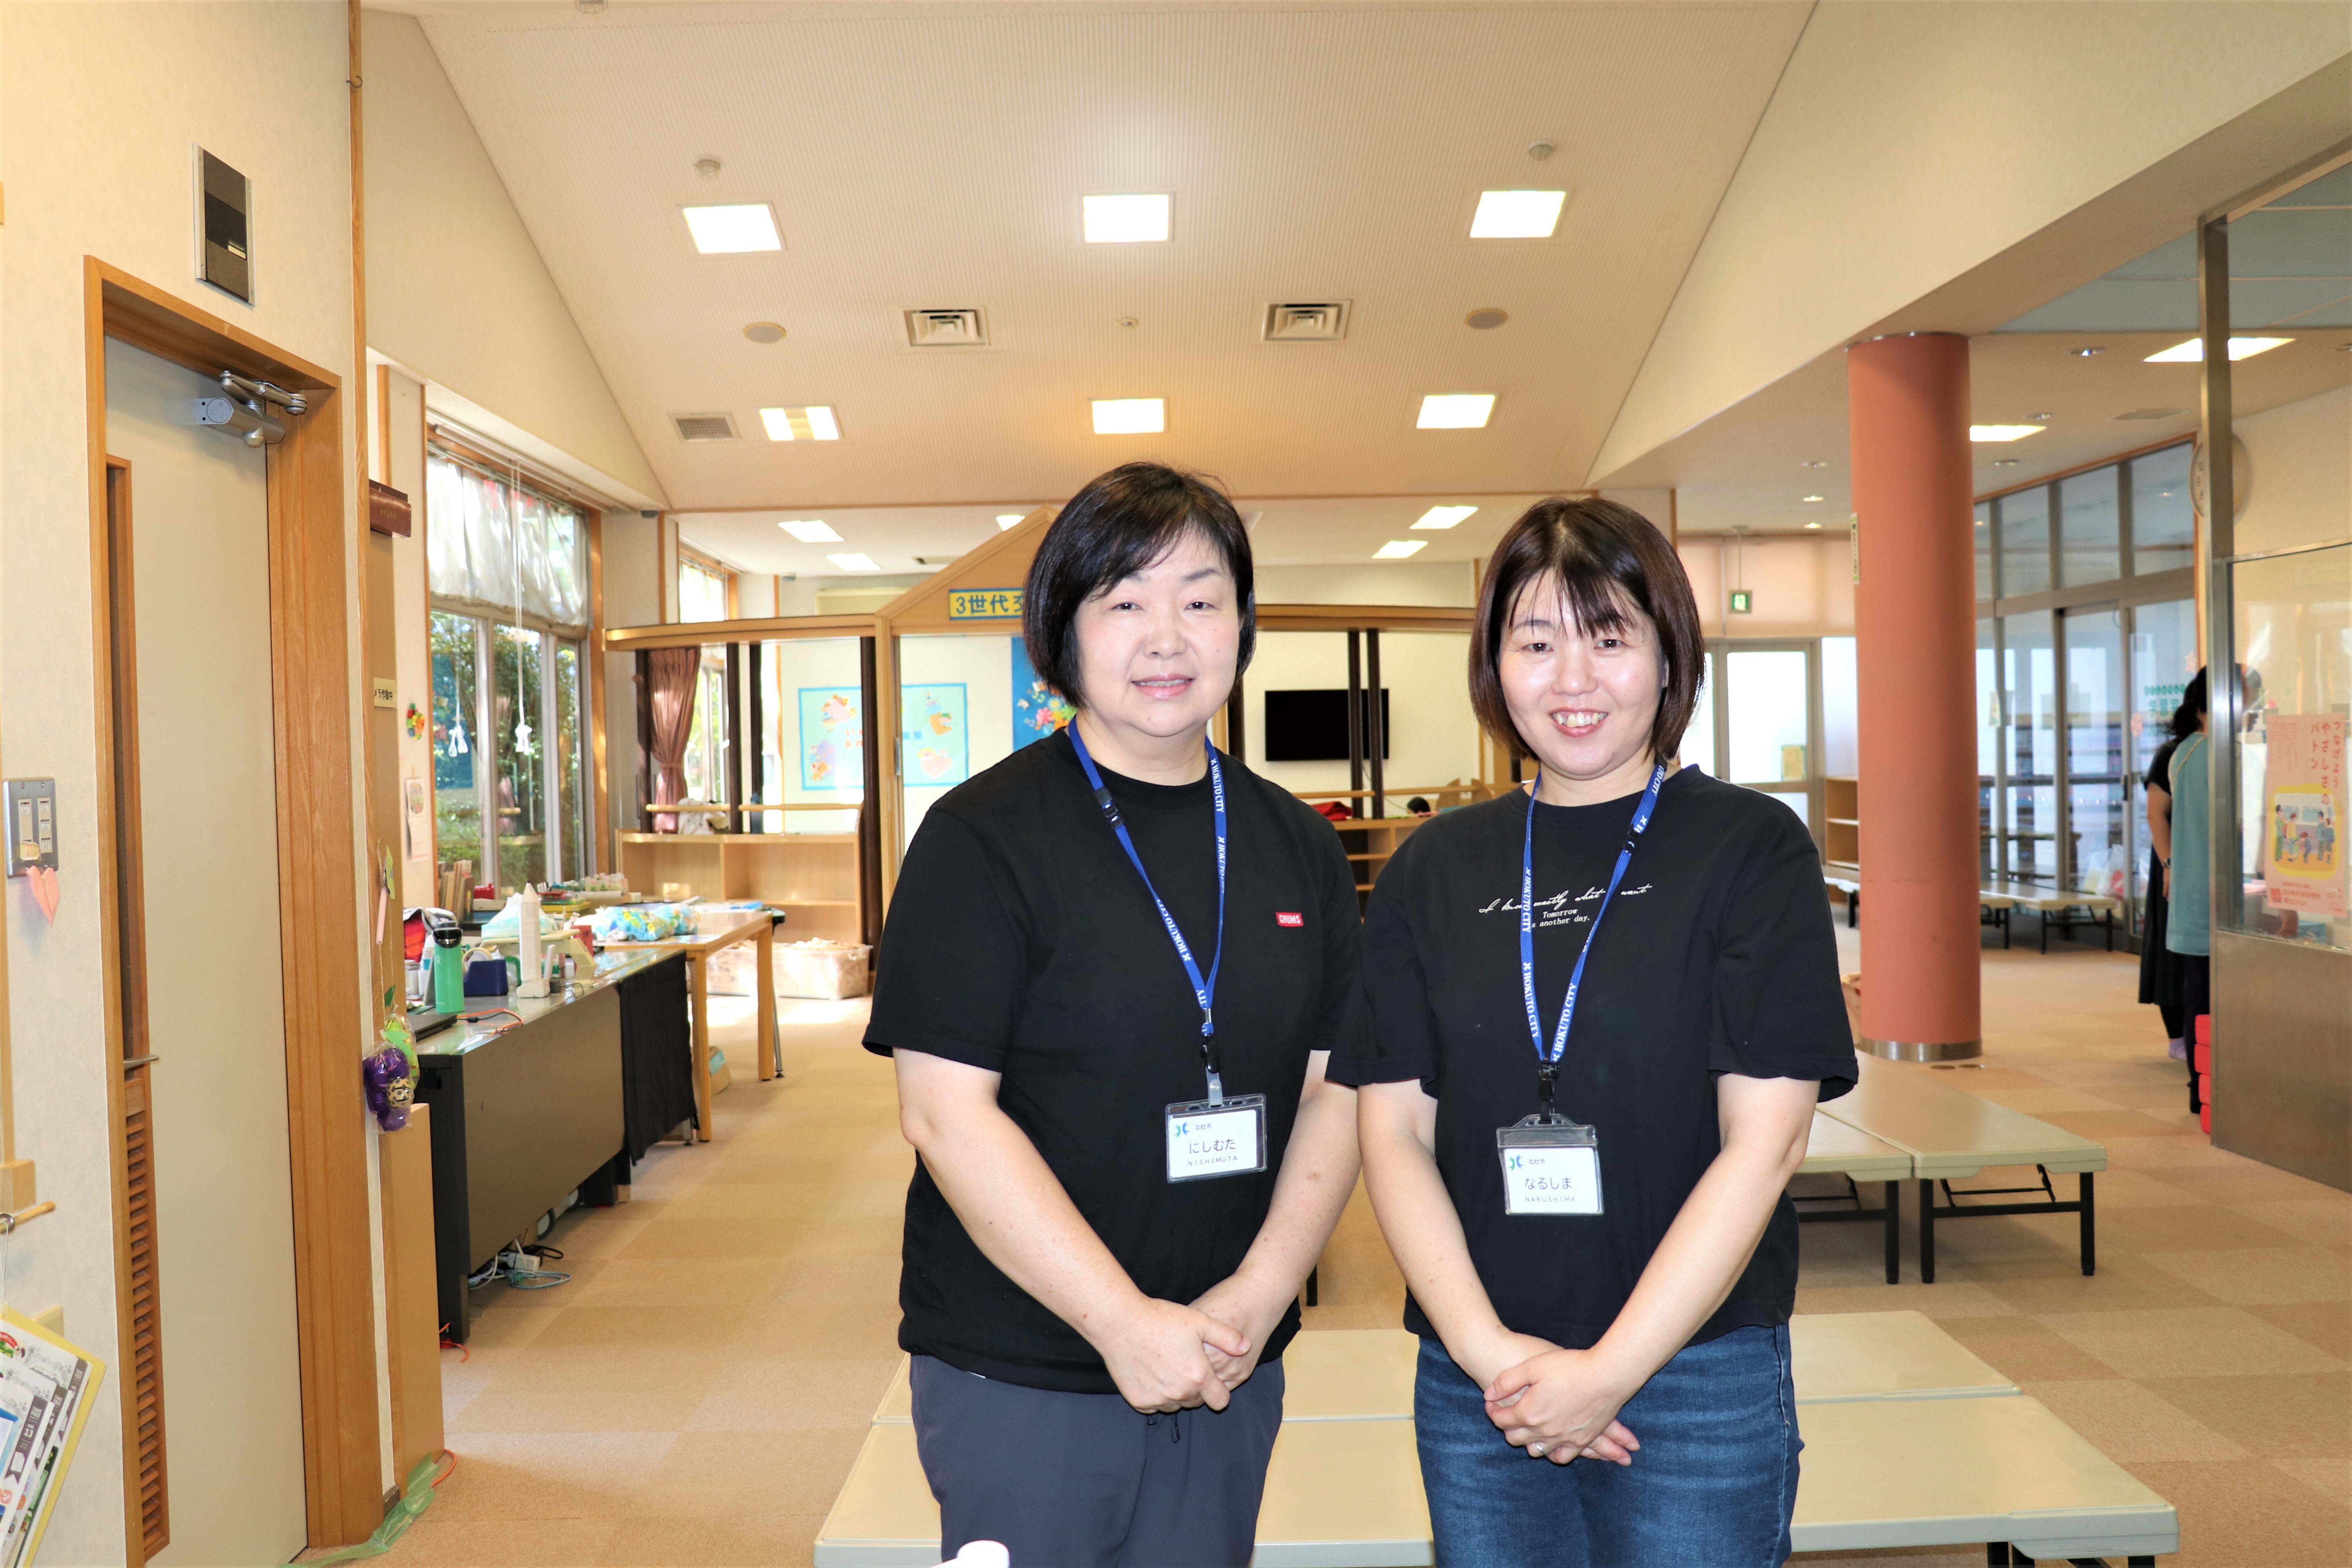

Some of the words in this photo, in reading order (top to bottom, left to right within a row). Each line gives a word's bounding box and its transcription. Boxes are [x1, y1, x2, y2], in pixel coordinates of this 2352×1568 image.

[2321, 722, 2330, 805] やさしさの
[1212, 764, 1222, 795] HOKUTO
[1215, 795, 1224, 813] CITY
[1522, 875, 1531, 911] HOKUTO
[1533, 890, 1569, 910] exactly
[1575, 886, 1606, 901] what
[1621, 884, 1652, 896] want
[1278, 914, 1301, 924] CHUMS
[1522, 912, 1531, 933] CITY
[1539, 918, 1570, 927] another
[1543, 908, 1578, 918] Tomorrow
[1165, 917, 1187, 953] HOKUTO
[1524, 971, 1535, 1013] HOKUTO
[1528, 1014, 1539, 1038] CITY
[1554, 1009, 1570, 1053] HOKUTO
[1565, 983, 1576, 1007] CITY
[1189, 1138, 1236, 1154] にしむた
[1188, 1155, 1238, 1166] NISHIMUTA
[1524, 1177, 1572, 1190] なるしま
[55, 1394, 63, 1402] TAKE
[24, 1428, 34, 1437] 13
